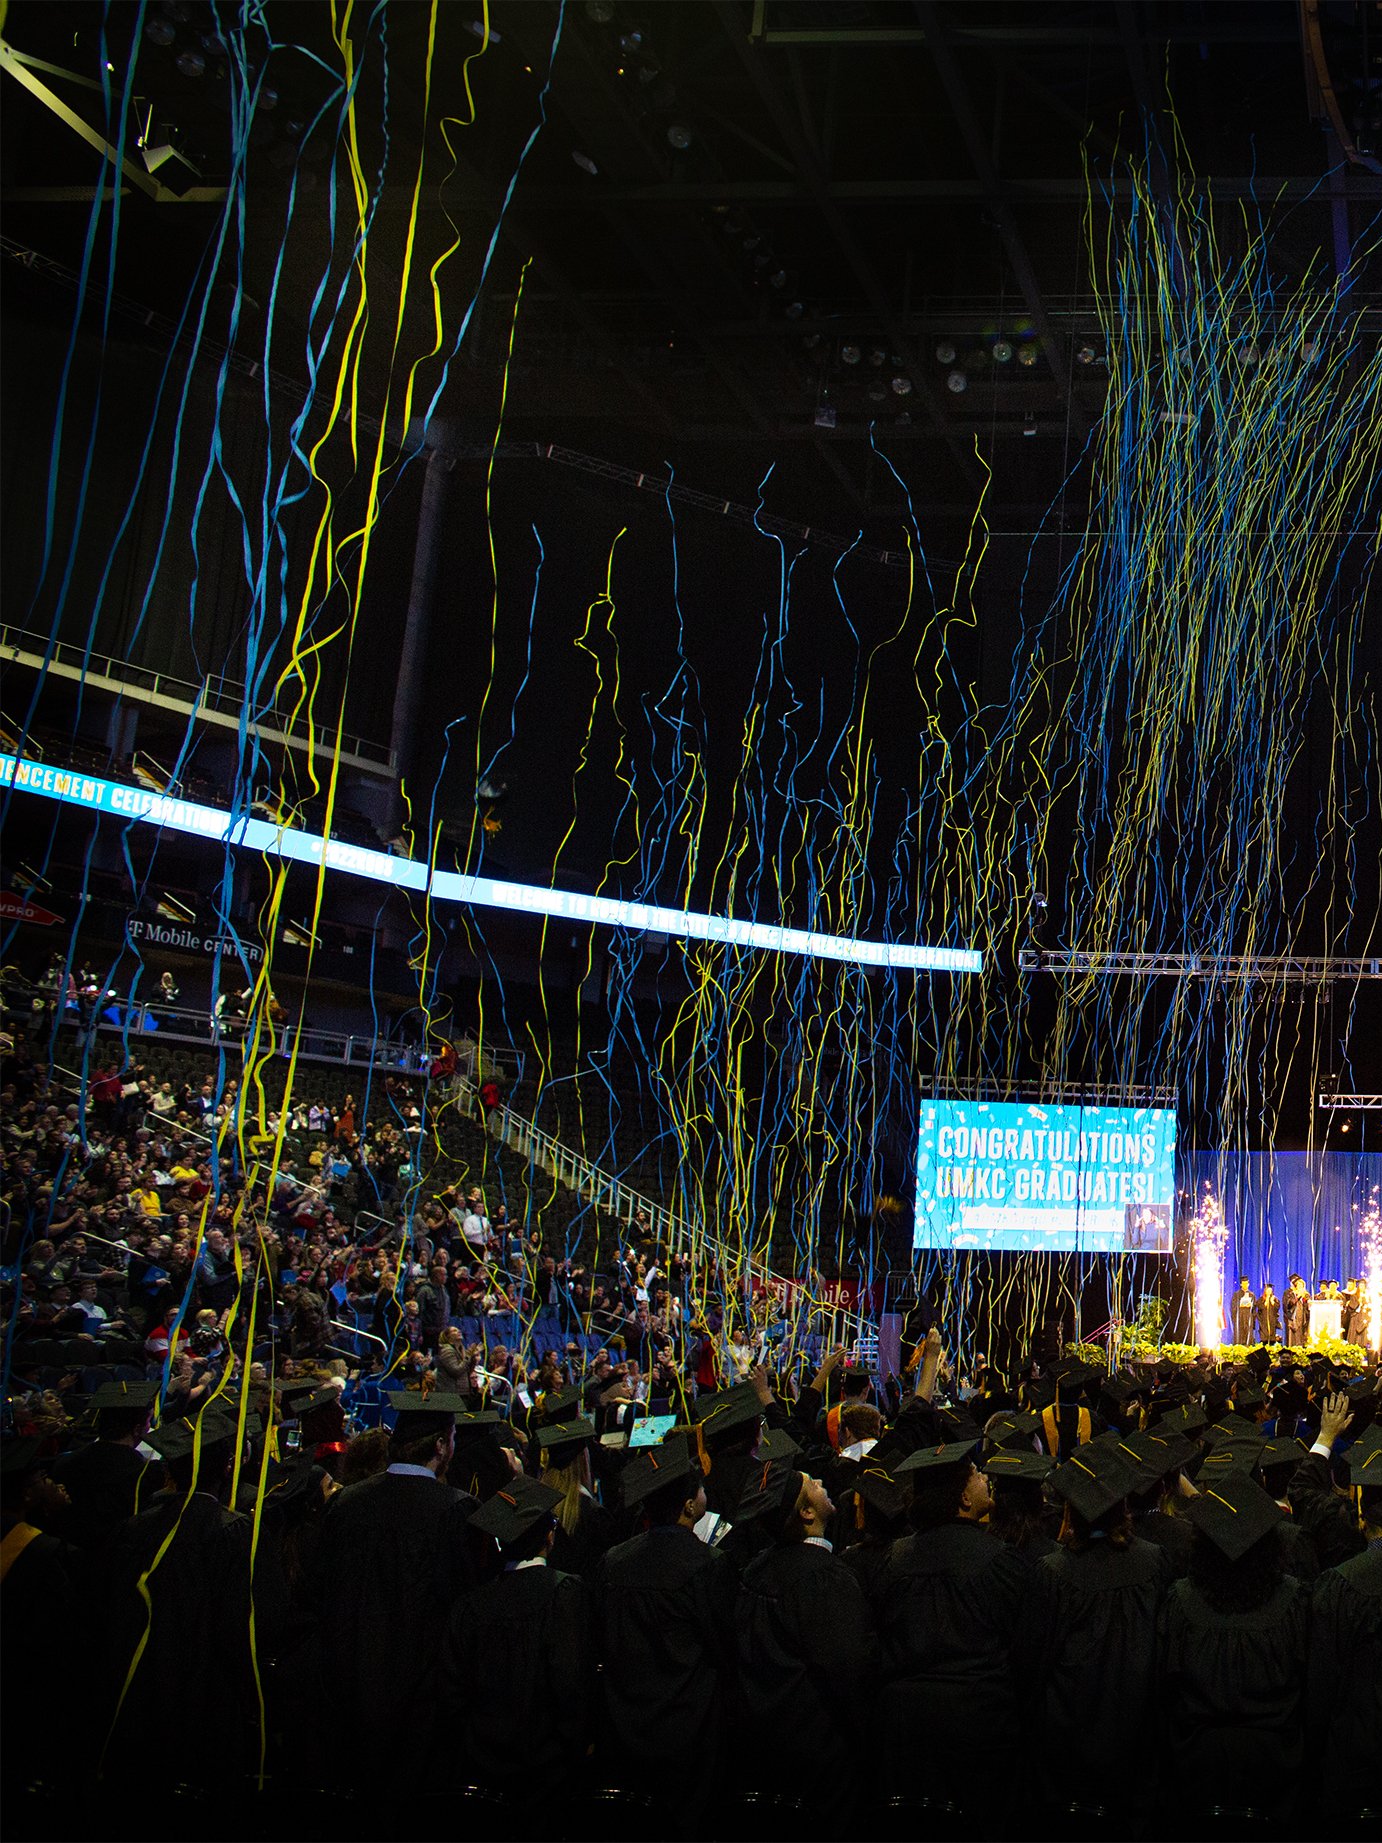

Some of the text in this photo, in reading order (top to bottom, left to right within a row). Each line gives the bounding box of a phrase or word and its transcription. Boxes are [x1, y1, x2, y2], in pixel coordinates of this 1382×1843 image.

[0, 757, 106, 804] ENCEMENT
[144, 923, 200, 949] Mobile
[938, 1126, 1156, 1165] CONGRATULATIONS
[936, 1166, 1154, 1203] UMKC GRADUATES!
